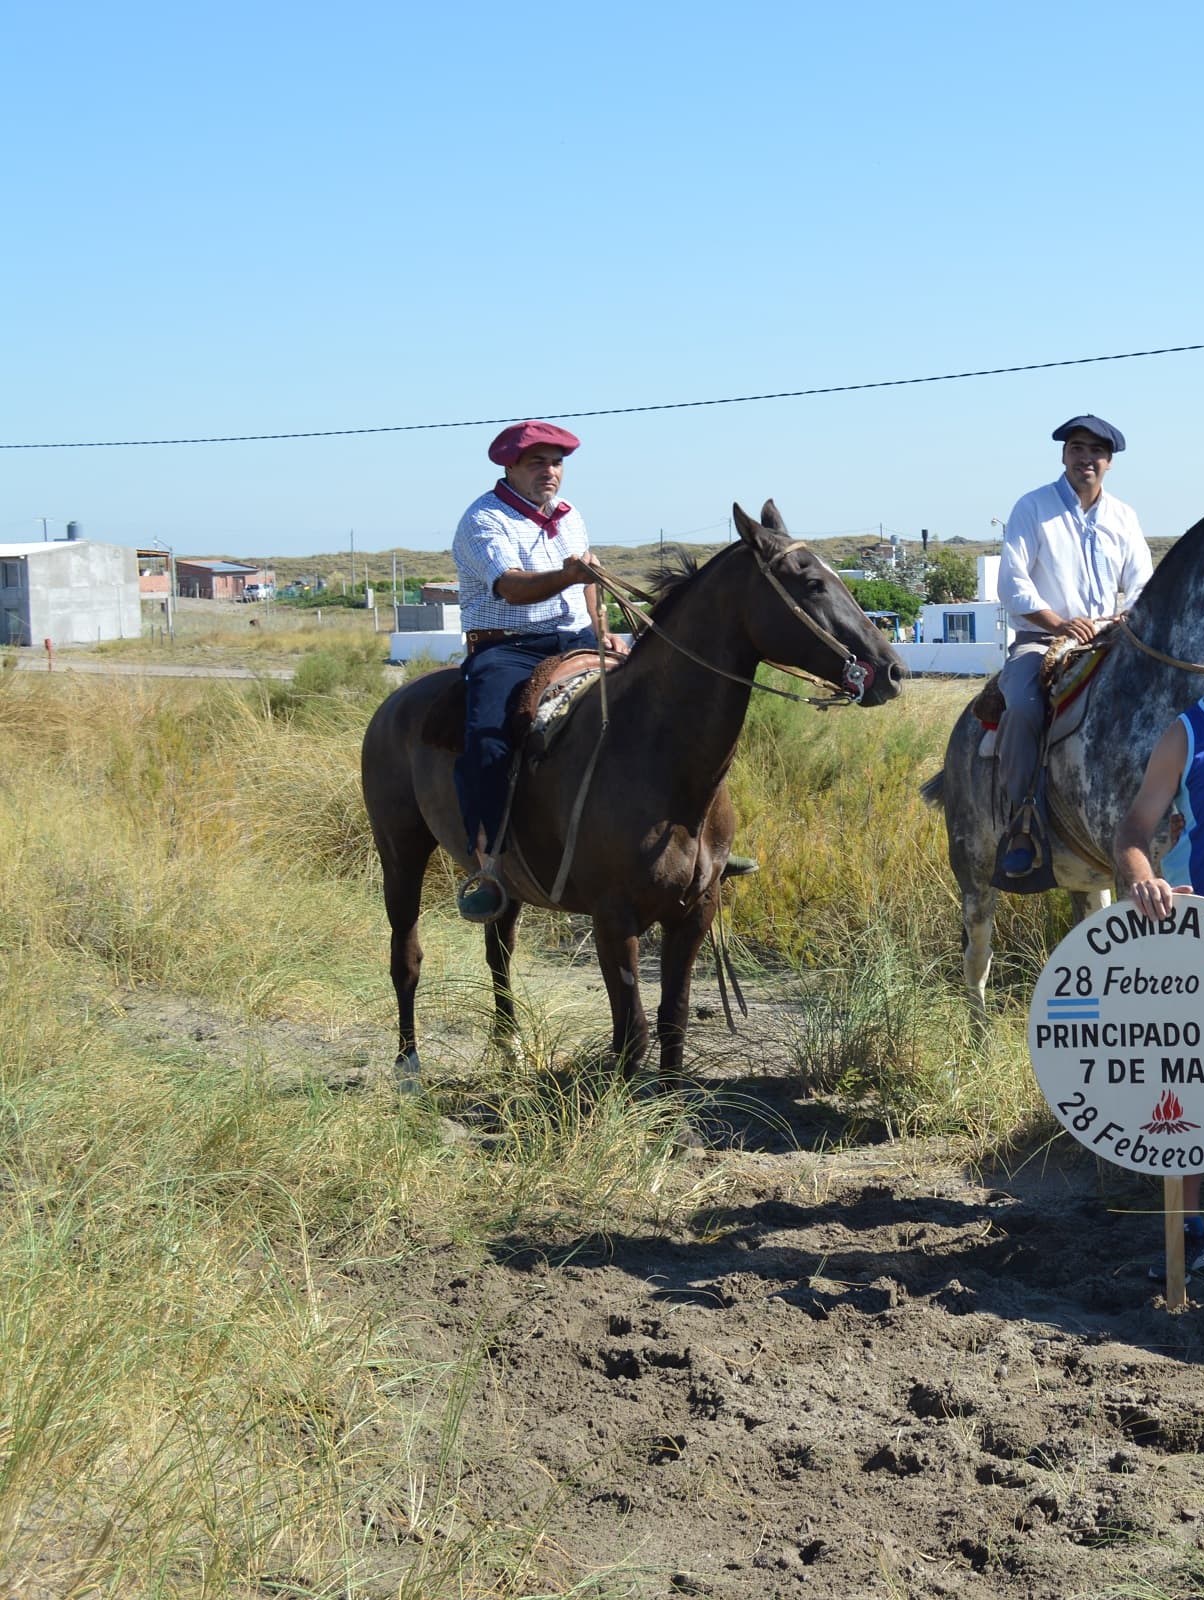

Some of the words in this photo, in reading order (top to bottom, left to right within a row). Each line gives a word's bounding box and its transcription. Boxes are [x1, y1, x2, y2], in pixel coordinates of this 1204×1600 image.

[1054, 966, 1093, 996] 28
[1103, 966, 1200, 995] Febrero
[1036, 1022, 1200, 1048] PRINCIPADO
[1080, 1059, 1095, 1084] 7
[1108, 1058, 1145, 1083] DE
[1057, 1092, 1098, 1131] 28
[1092, 1122, 1204, 1167] Febrero
